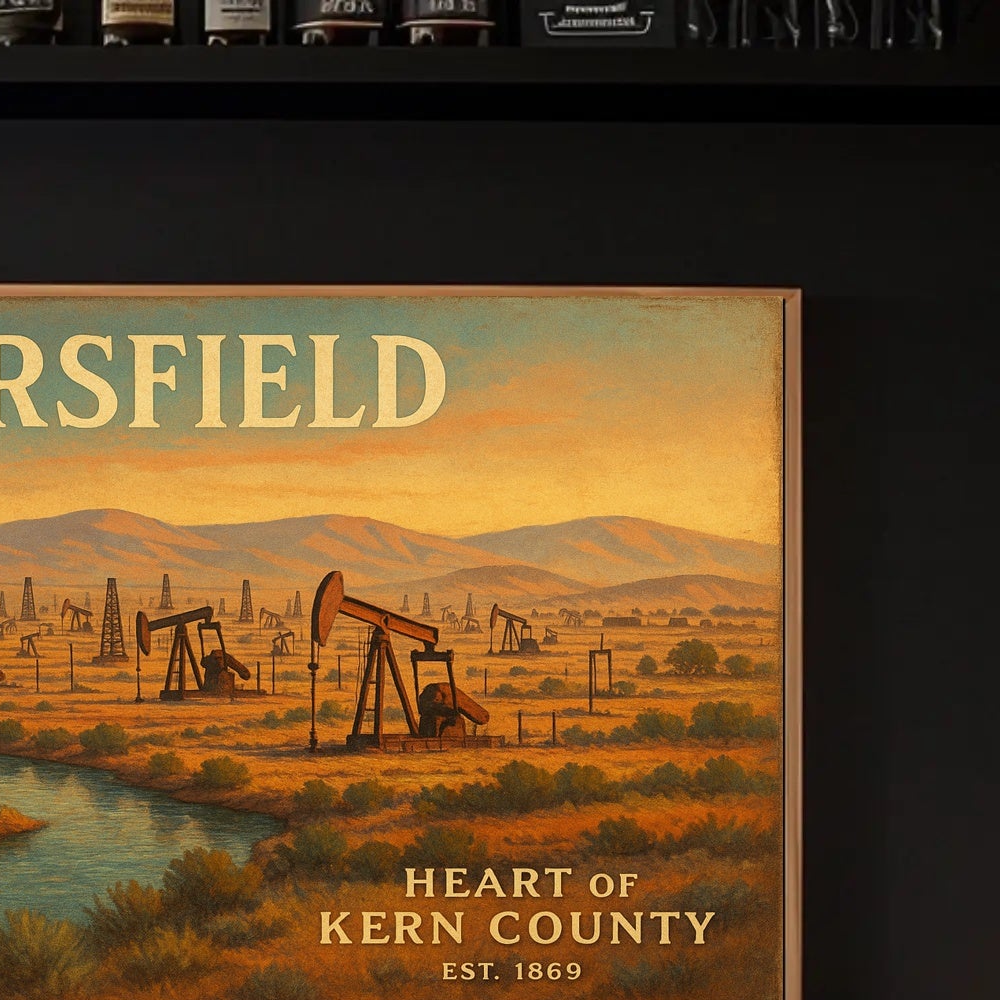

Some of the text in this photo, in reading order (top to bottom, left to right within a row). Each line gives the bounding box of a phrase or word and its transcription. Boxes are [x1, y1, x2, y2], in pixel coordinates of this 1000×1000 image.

[405, 868, 638, 898] HEART OF
[319, 911, 716, 945] KERN COUNTY
[442, 962, 583, 981] EST. 1869
